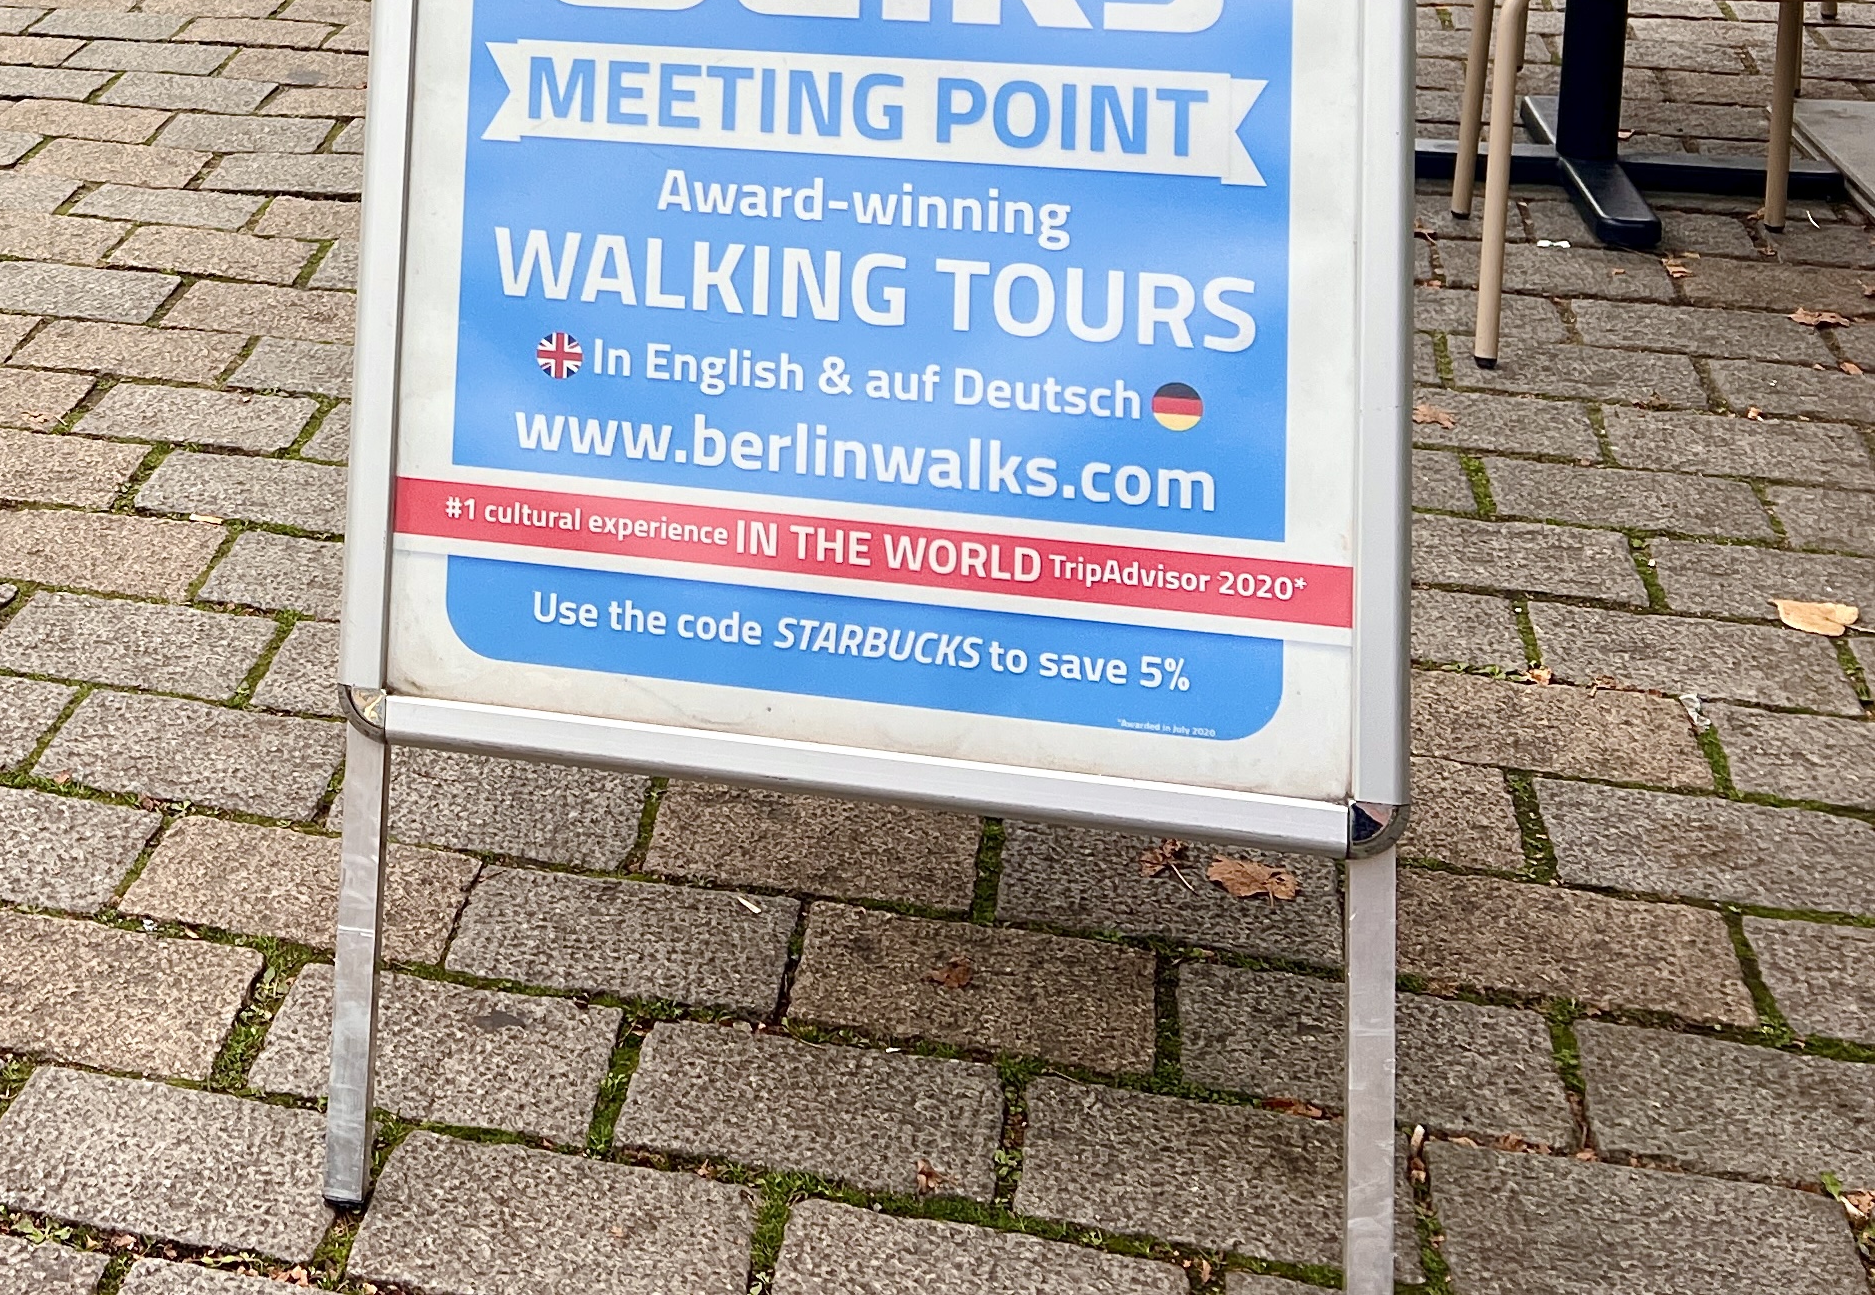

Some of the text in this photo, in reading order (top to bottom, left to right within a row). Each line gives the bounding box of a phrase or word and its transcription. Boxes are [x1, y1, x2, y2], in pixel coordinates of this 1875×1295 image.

[528, 57, 1209, 157] MEETING POINT
[656, 168, 1071, 251] Award-winning
[494, 225, 1256, 353] WALKING TOURS
[593, 337, 1141, 419] In English & auf Deutsch
[514, 410, 1215, 511] www.berlinwalks.com
[445, 496, 476, 520] #1
[484, 501, 581, 531] cultural
[588, 512, 729, 546] experience
[736, 519, 778, 557] IN
[789, 524, 872, 566] THE
[883, 533, 1041, 582] WORLD
[1048, 554, 1211, 593] TripAdvisor
[533, 591, 1190, 691] Use the code STARBUCKS to save 5%
[1162, 723, 1171, 732] in
[1192, 727, 1216, 737] 2020
